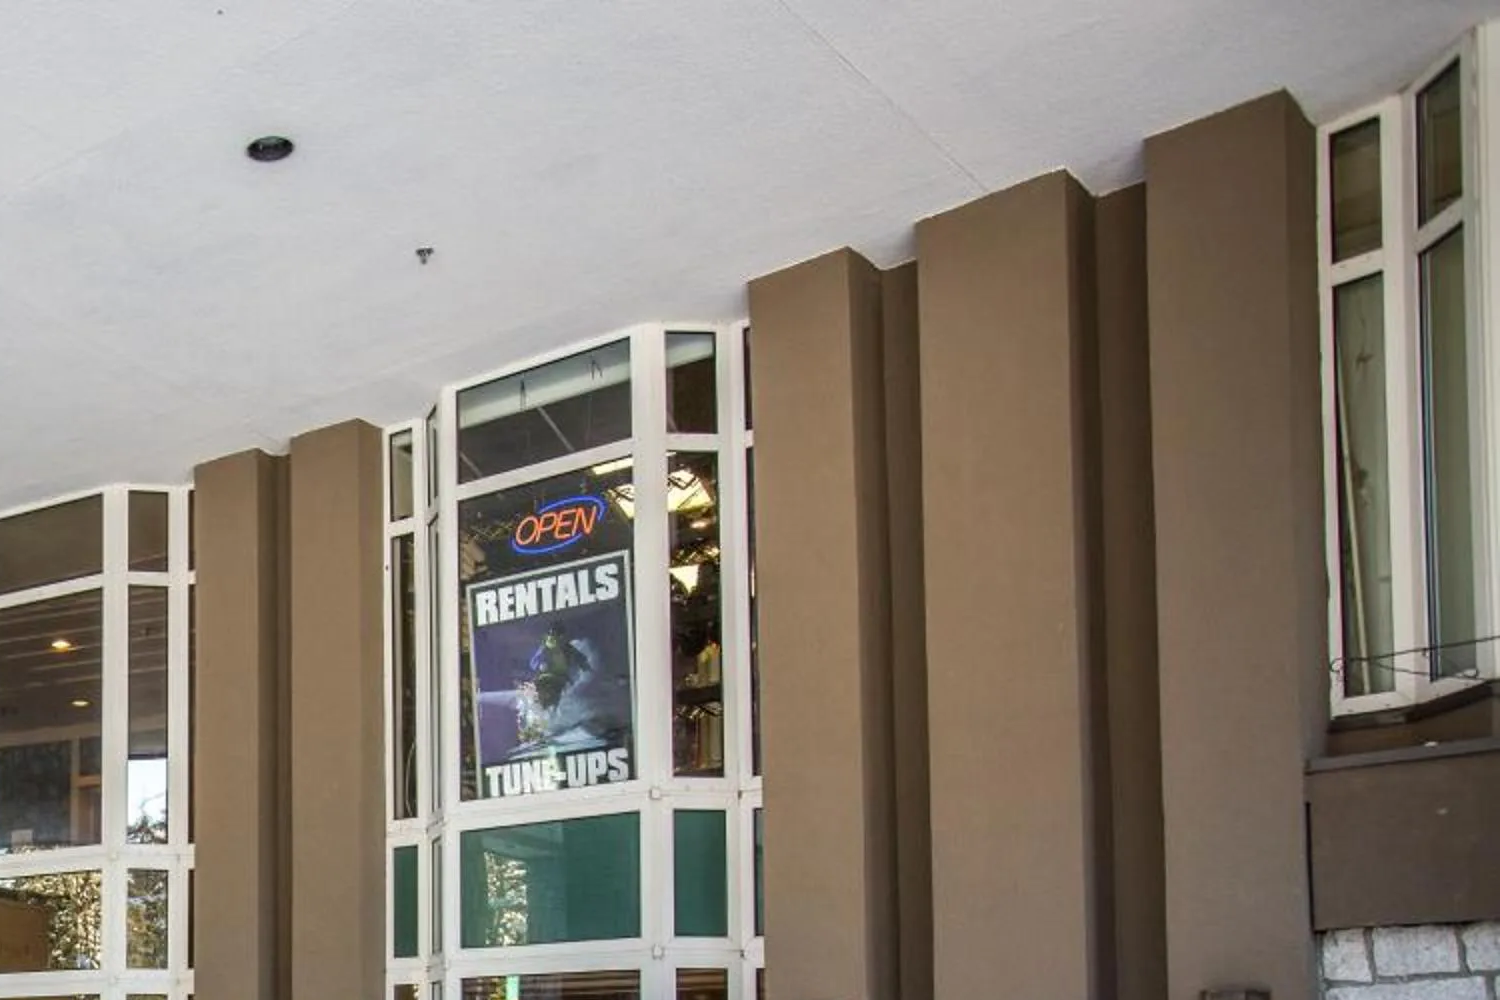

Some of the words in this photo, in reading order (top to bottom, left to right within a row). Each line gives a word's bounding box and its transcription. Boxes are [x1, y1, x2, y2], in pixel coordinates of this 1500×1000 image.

[515, 505, 598, 546] OPEN
[475, 563, 620, 627] RENTALS
[485, 748, 630, 798] TUNE-UPS
